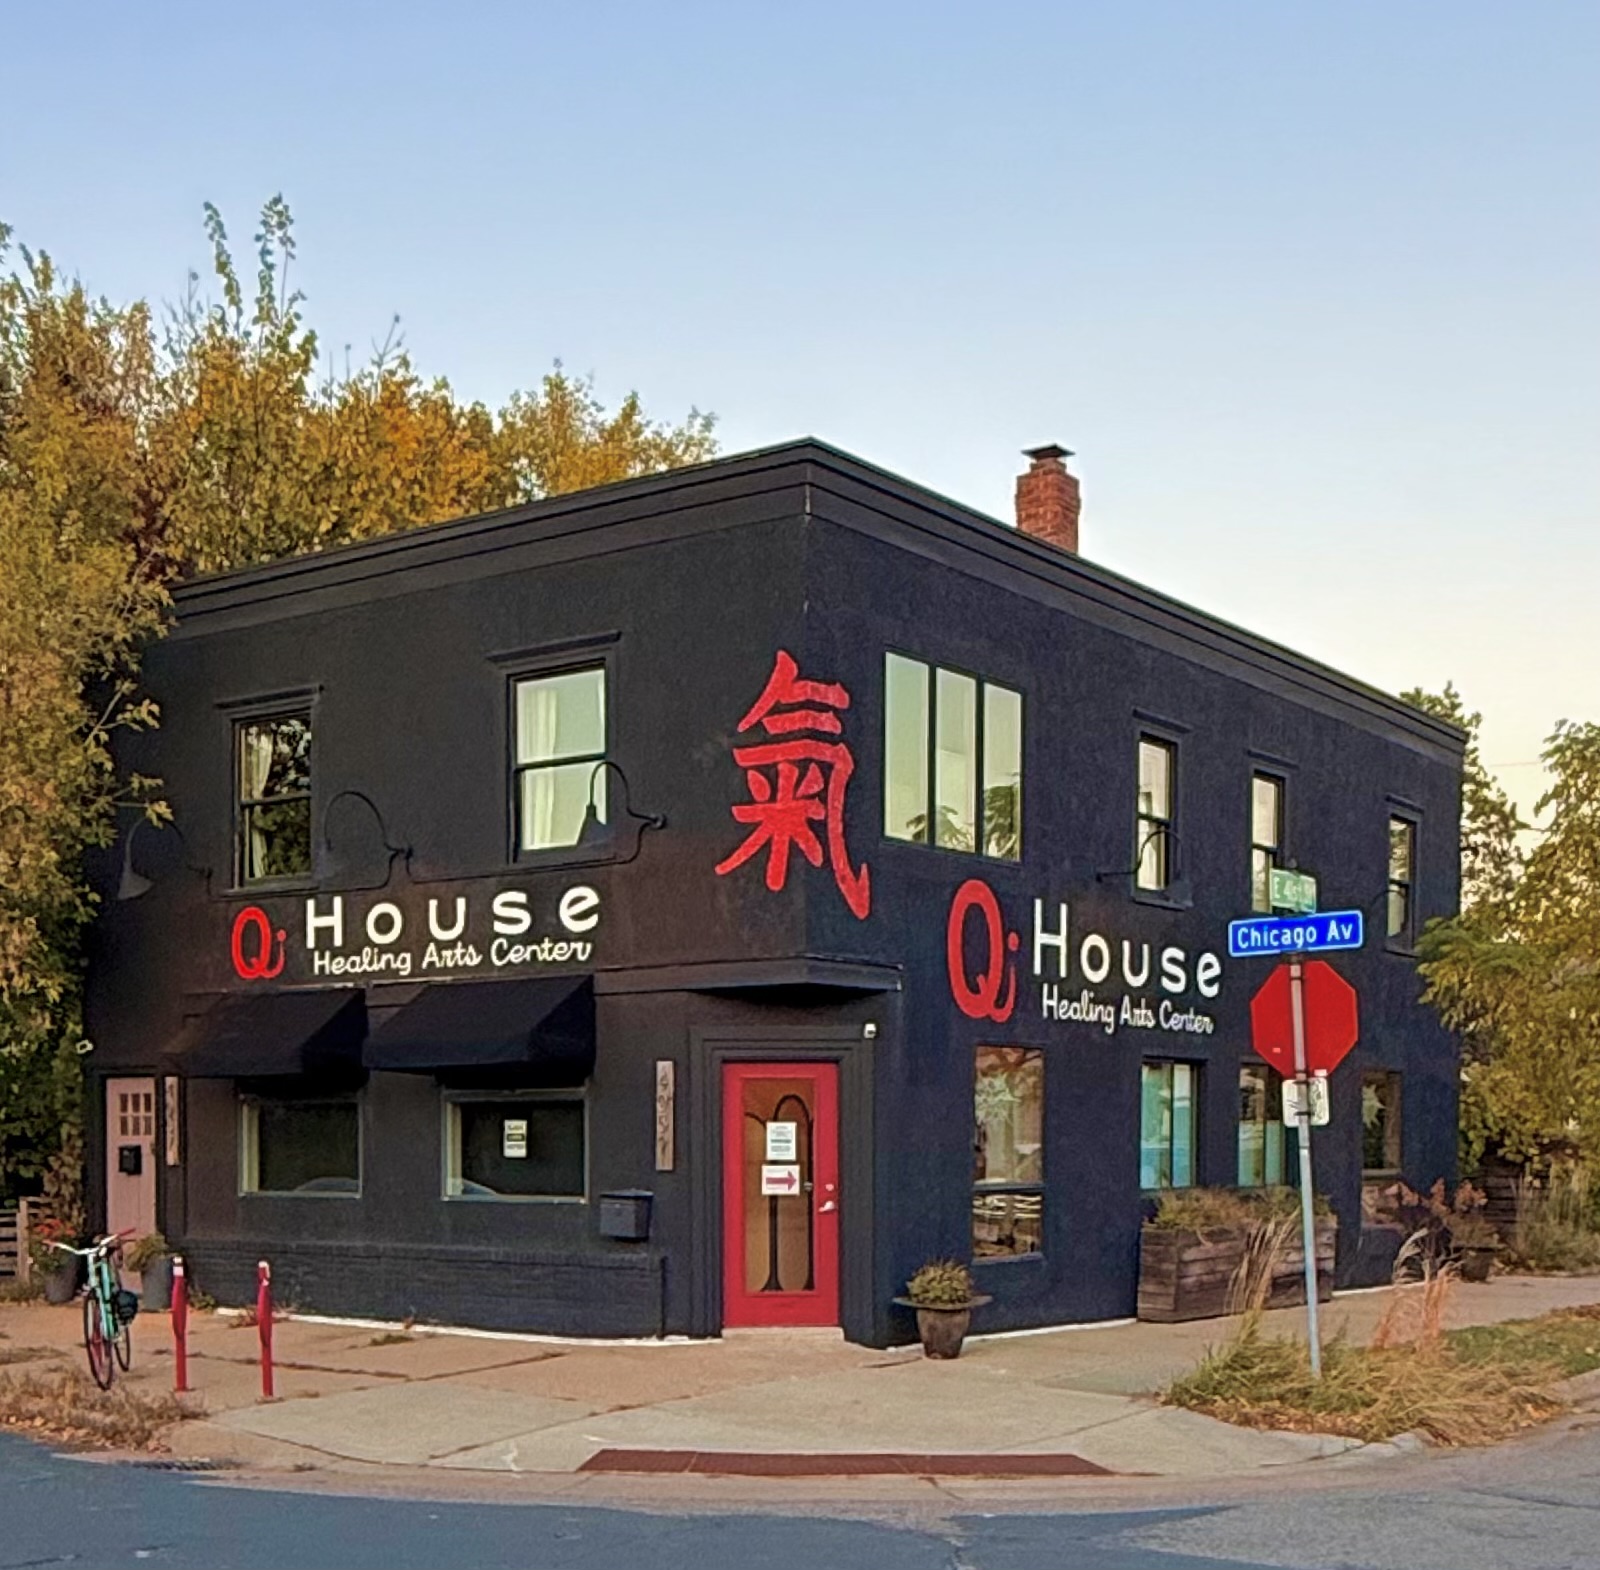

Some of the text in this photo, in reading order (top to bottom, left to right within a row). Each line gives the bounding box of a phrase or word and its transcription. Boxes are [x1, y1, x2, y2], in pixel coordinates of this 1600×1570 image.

[714, 650, 871, 920] 氣
[231, 886, 600, 979] Qi House
[313, 936, 592, 976] Healing Arts Center
[947, 879, 1222, 1023] Qi House
[1237, 919, 1354, 949] Chicago Av
[1042, 982, 1215, 1035] Healing Arts Center
